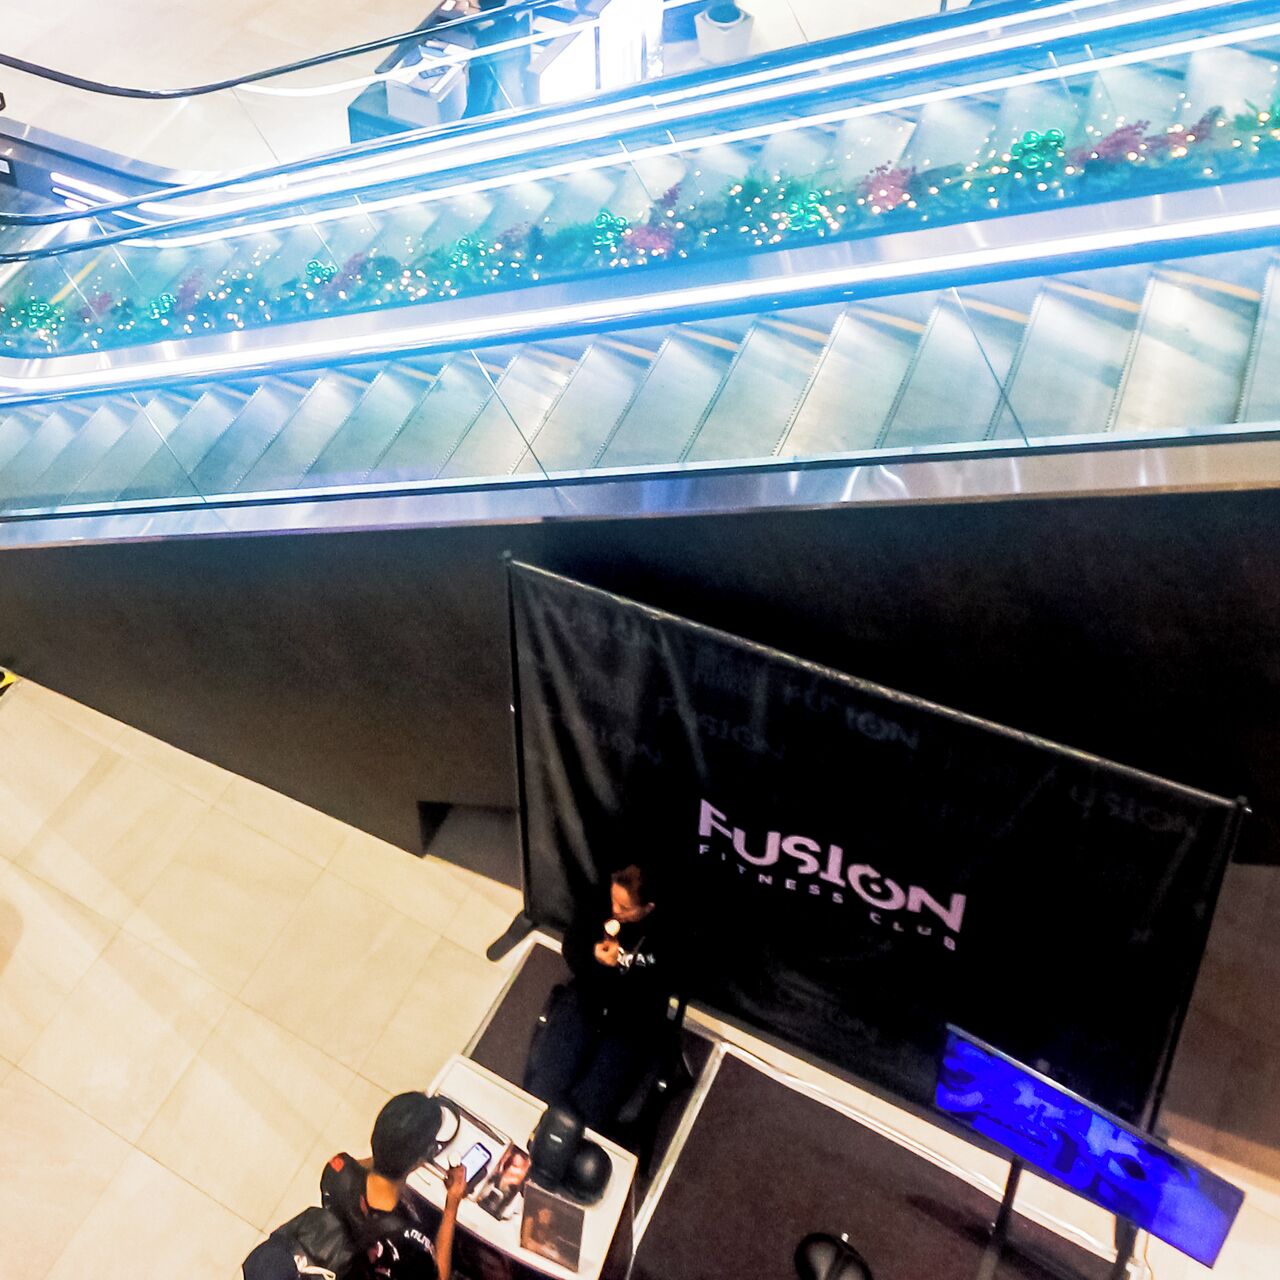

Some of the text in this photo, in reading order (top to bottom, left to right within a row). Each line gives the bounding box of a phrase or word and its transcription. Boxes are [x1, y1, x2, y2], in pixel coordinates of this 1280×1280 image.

[698, 799, 966, 933] FUSION
[699, 844, 955, 951] FITNESS CLUB
